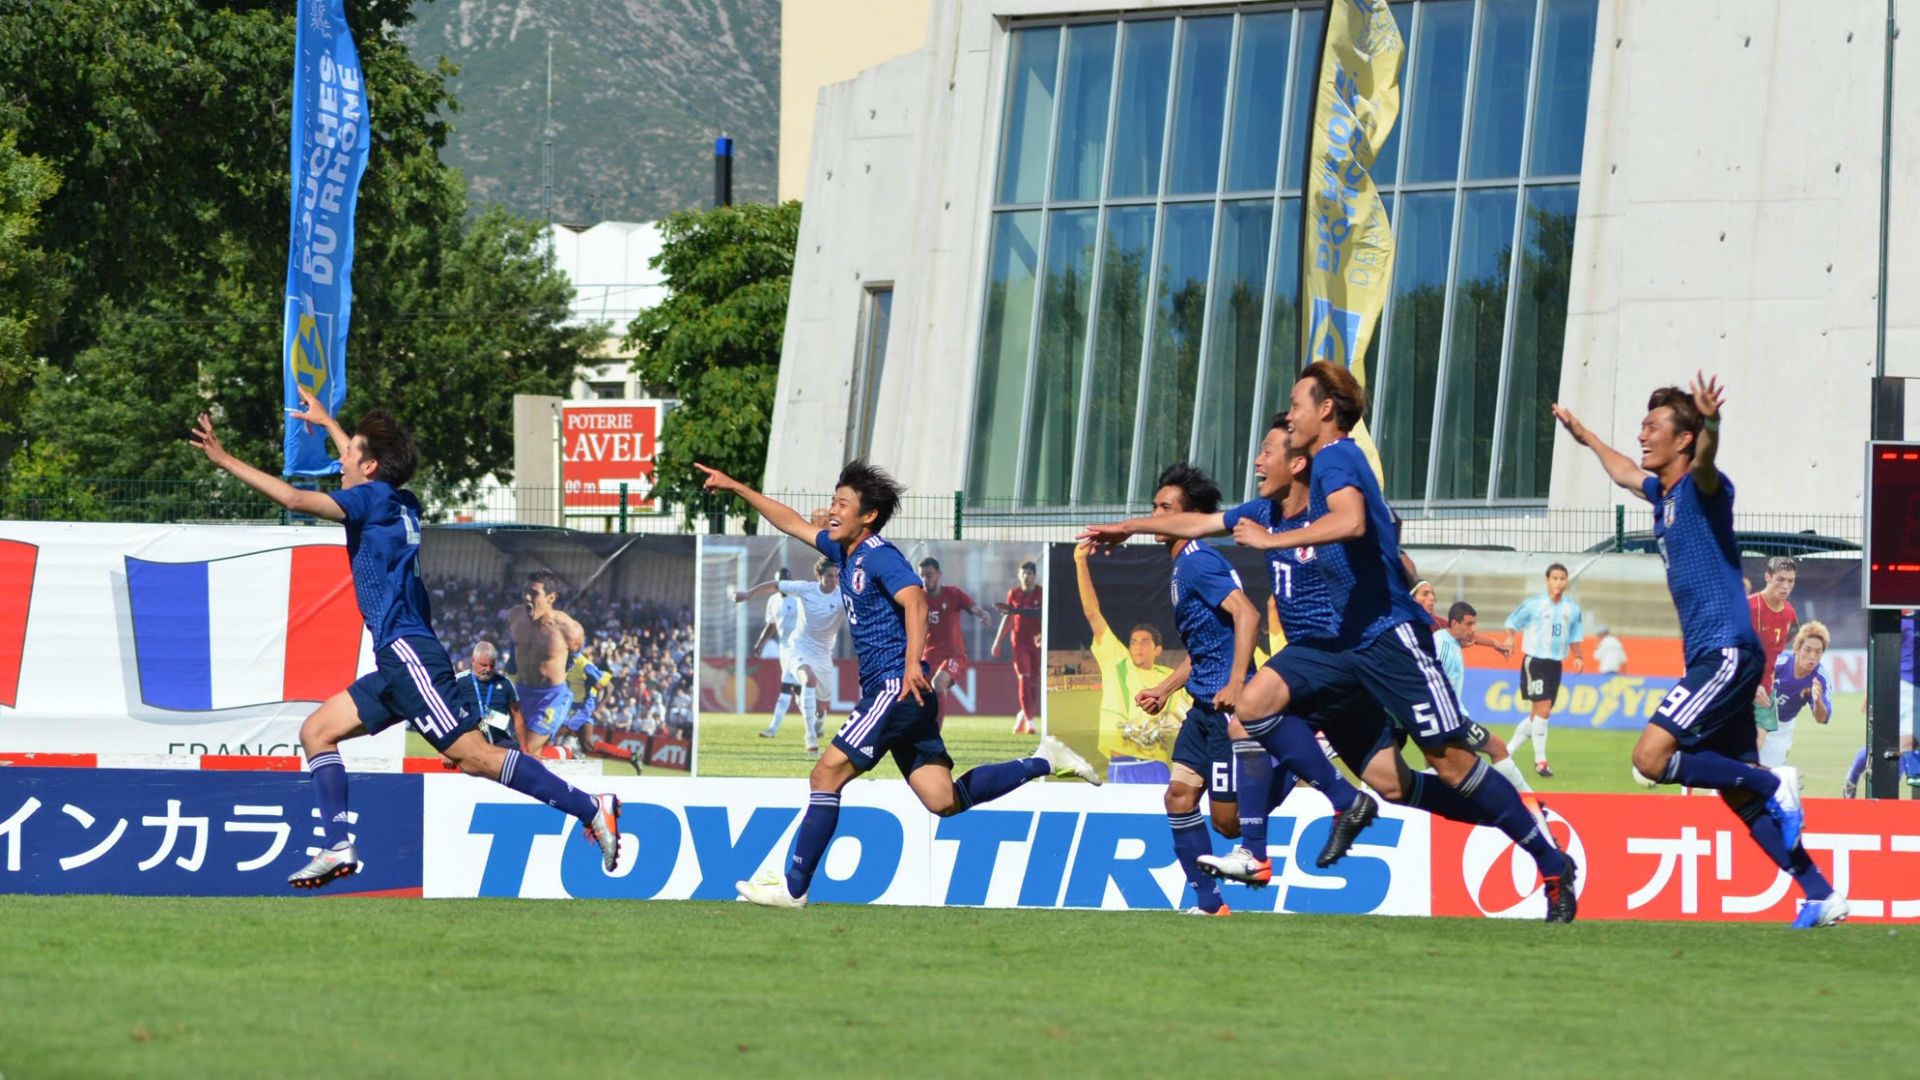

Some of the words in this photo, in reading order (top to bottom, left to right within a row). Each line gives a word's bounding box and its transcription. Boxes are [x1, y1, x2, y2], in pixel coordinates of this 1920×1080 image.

[568, 414, 633, 430] POTERIE
[1552, 623, 1562, 637] 18
[1656, 685, 1692, 717] 9
[414, 714, 443, 740] 4
[1411, 702, 1440, 738] 5
[1212, 761, 1229, 792] 6
[467, 802, 905, 905] TOYO
[934, 809, 1405, 916] TIRES
